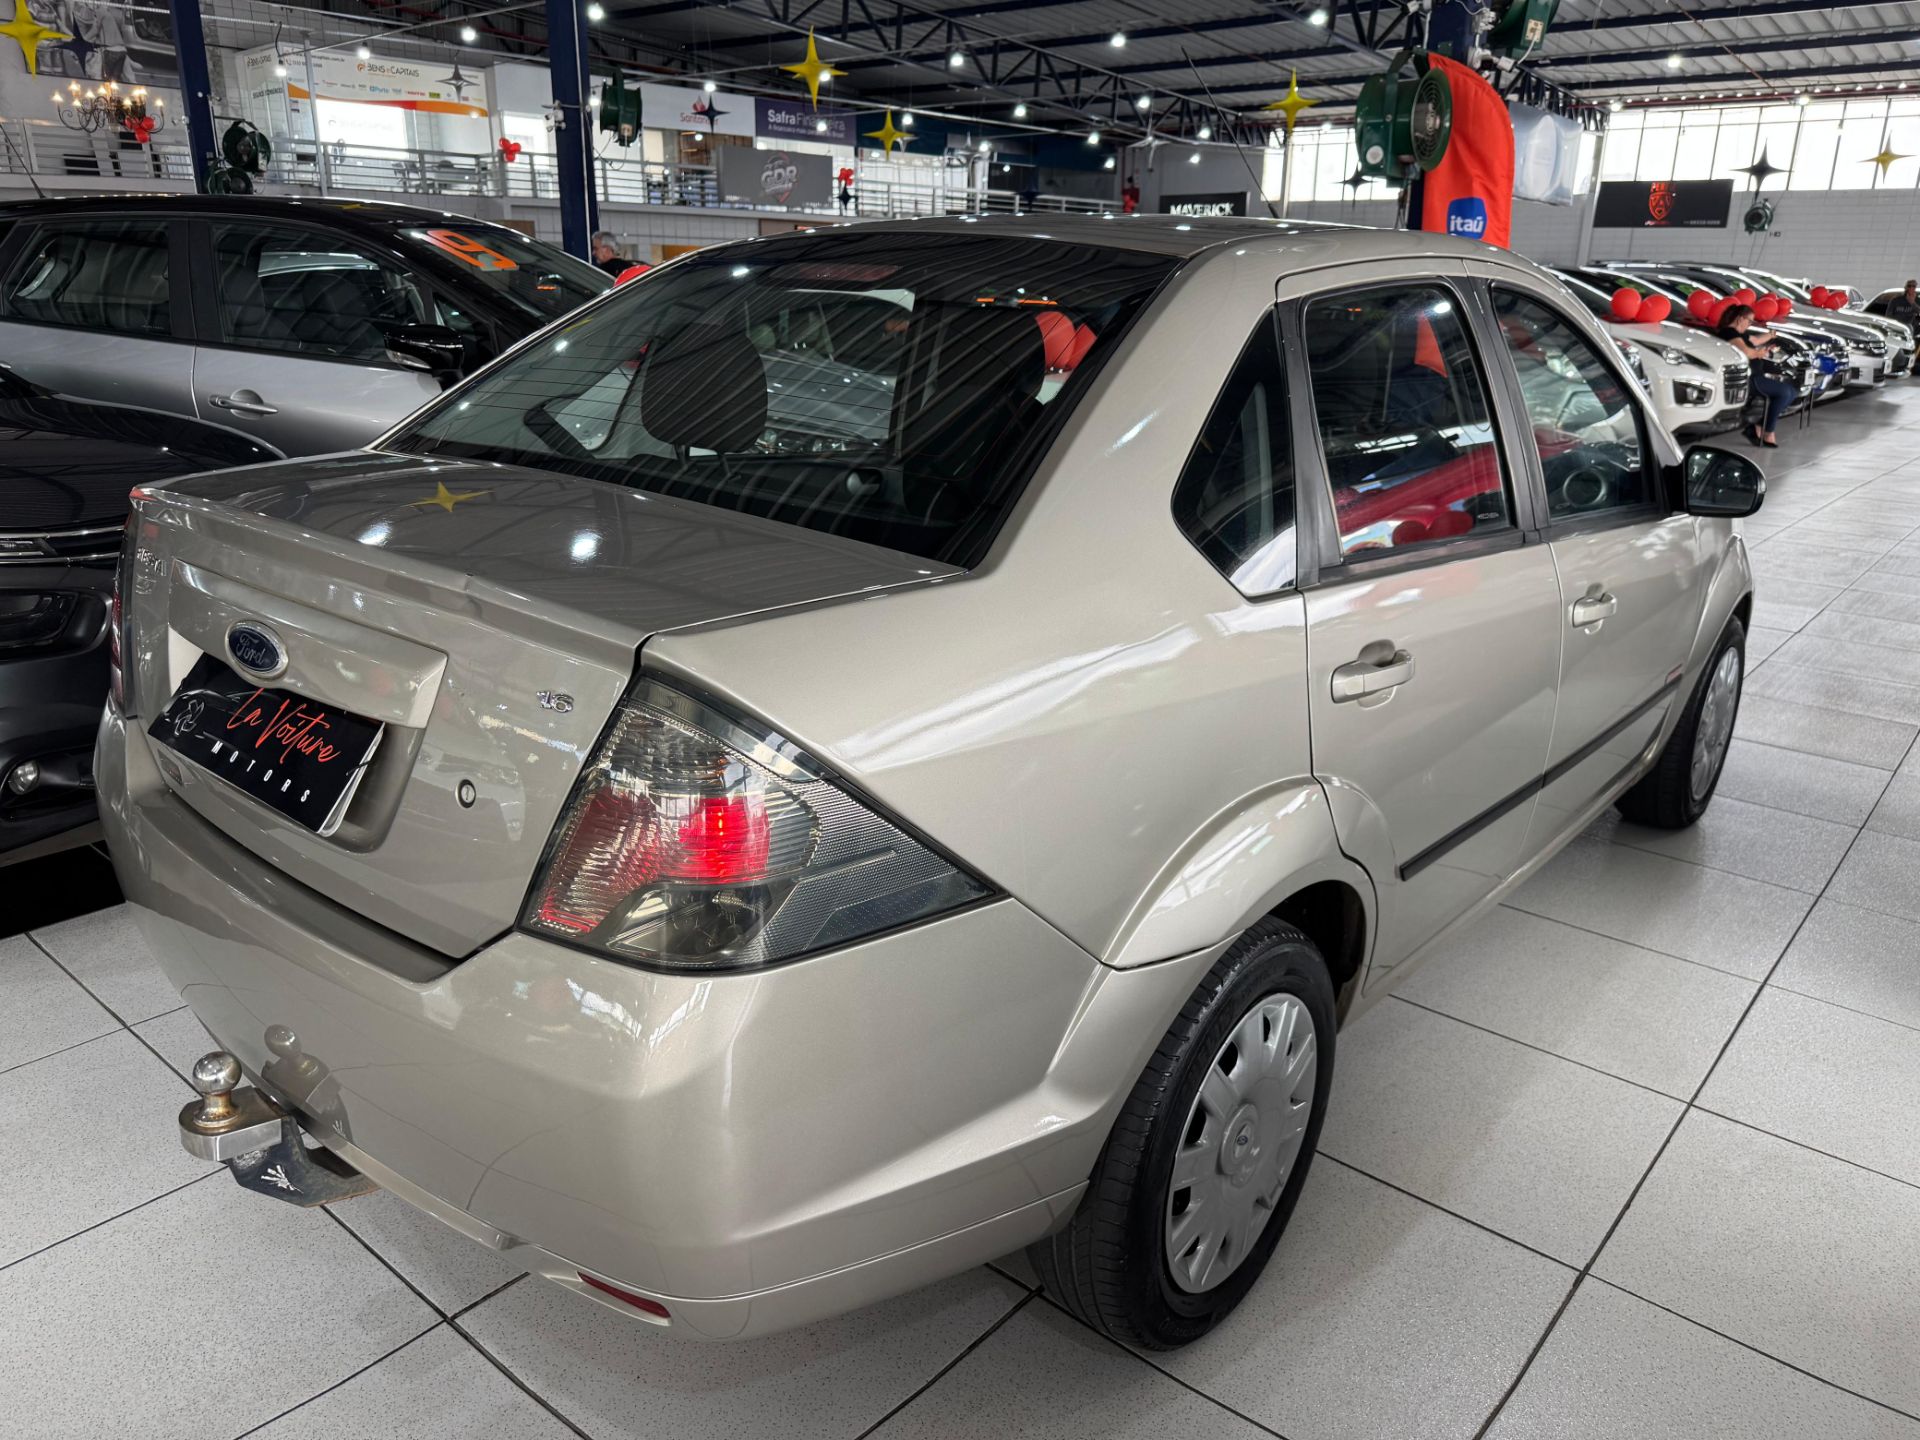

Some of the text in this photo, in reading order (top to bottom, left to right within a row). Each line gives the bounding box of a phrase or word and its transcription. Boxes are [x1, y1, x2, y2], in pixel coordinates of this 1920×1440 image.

[1169, 202, 1234, 217] MAVERICK
[1449, 215, 1484, 233] itaú
[236, 631, 266, 667] Ford
[226, 687, 342, 765] La Voiture
[210, 740, 311, 803] MOTORS
